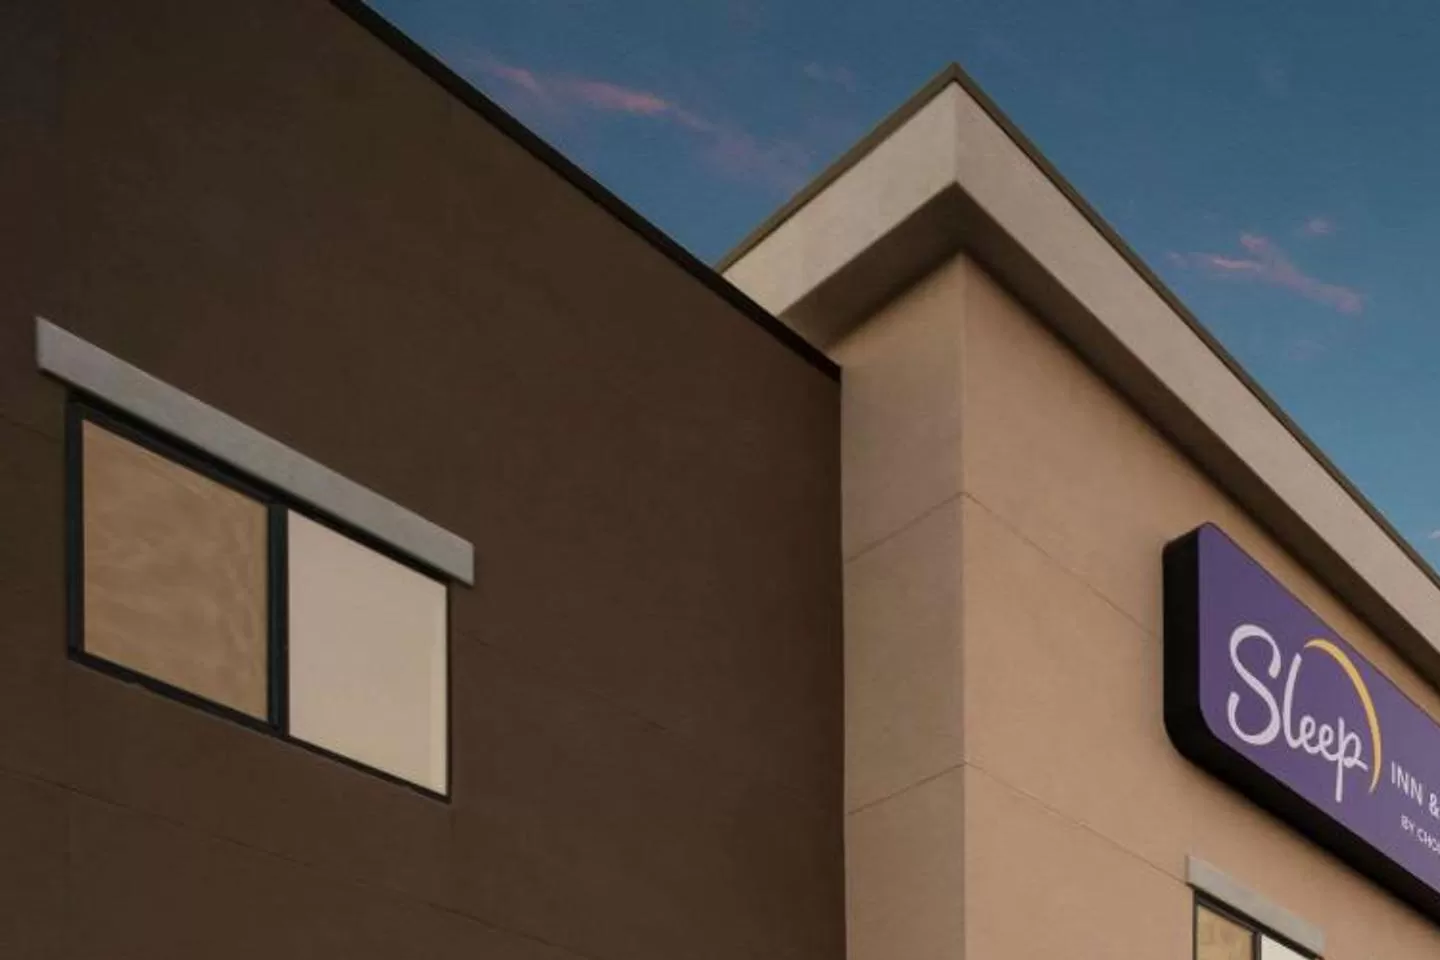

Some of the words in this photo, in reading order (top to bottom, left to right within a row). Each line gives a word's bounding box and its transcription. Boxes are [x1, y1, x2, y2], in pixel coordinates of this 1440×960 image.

[1227, 624, 1368, 803] Sleep
[1391, 760, 1423, 806] INN
[1428, 792, 1440, 819] &
